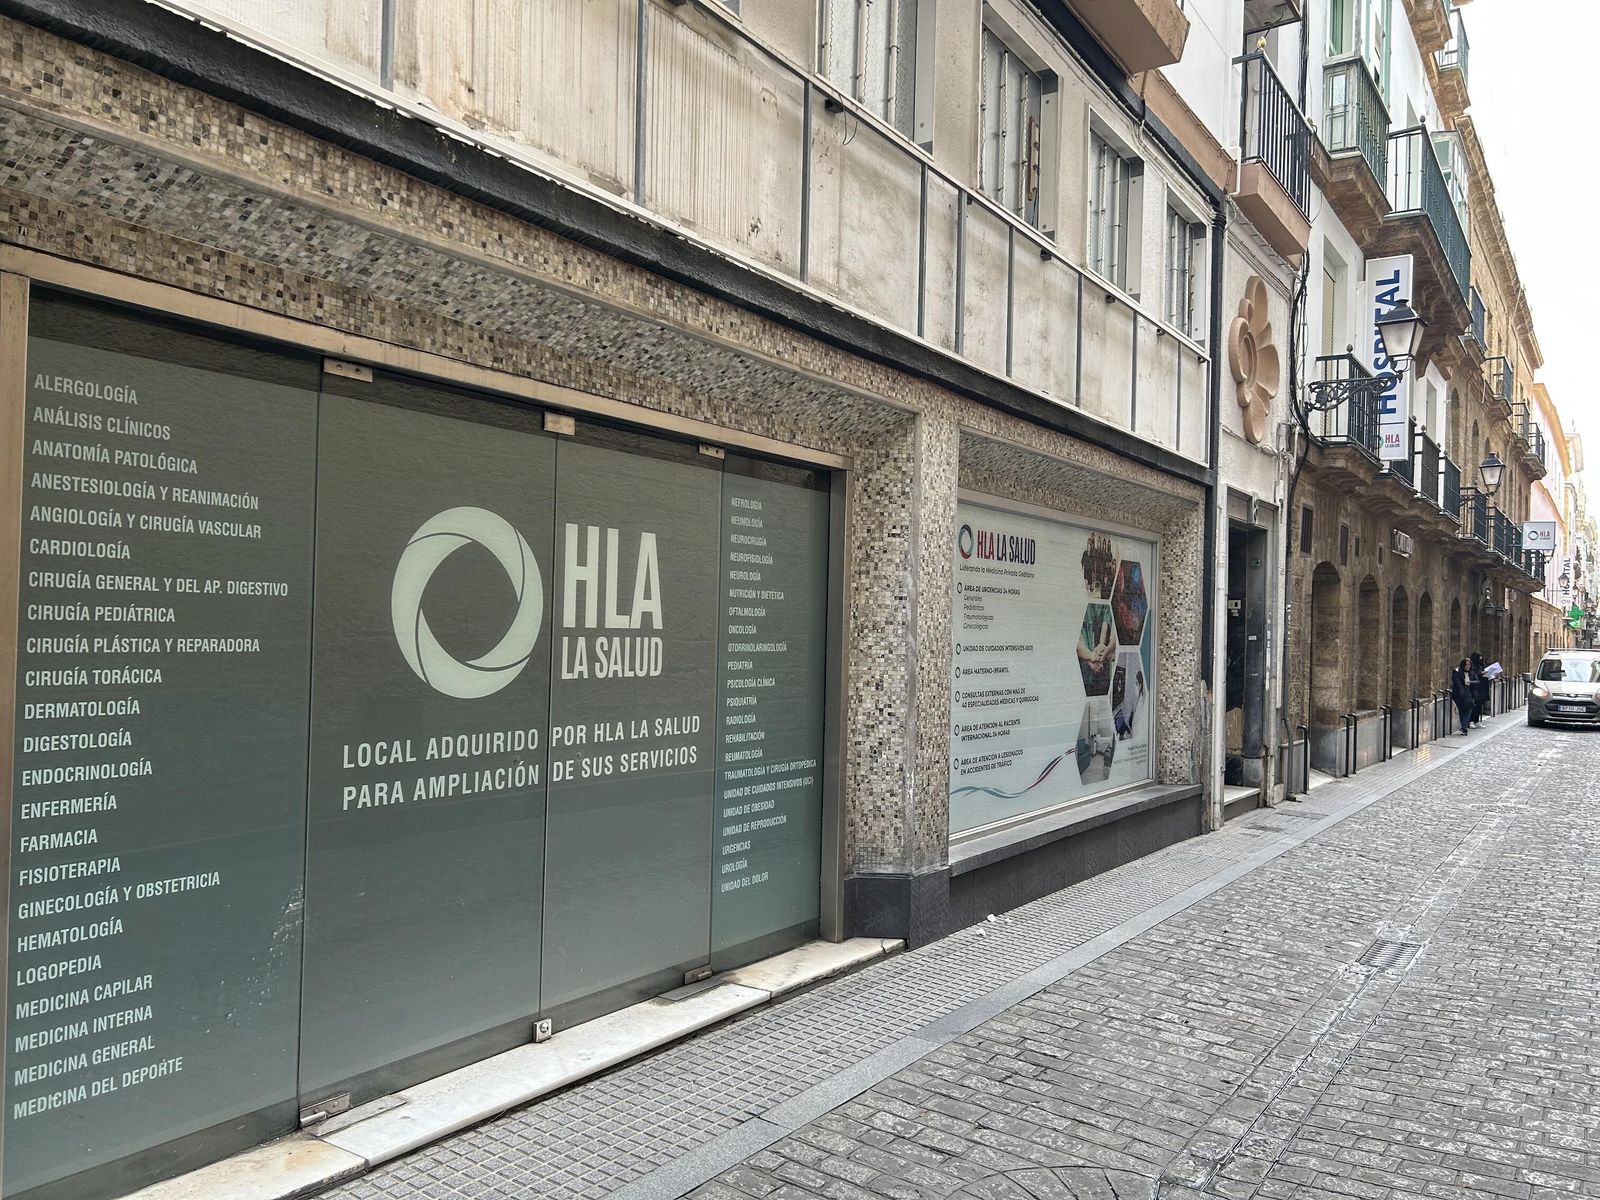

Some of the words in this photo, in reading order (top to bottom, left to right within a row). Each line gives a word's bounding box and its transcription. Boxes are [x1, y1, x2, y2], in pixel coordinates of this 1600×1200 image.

[1373, 269, 1400, 415] HOSTAL
[34, 374, 138, 405] ALERGOLOGÍA
[33, 407, 102, 431] ANÁLISIS
[107, 417, 171, 440] CLÍNICOS
[1385, 434, 1400, 444] HLA
[32, 440, 110, 464] ANATOMÍA
[115, 449, 198, 474] PATOLÓGICA
[31, 473, 155, 500] ANESTESIOLOGÍA
[160, 485, 168, 501] Y
[173, 486, 259, 510] REANIMACIÓN
[731, 498, 762, 510] NEFROLOGÍA
[30, 506, 122, 528] ANGIOLOGÍA
[127, 514, 134, 528] Y
[140, 515, 194, 533] CIRUGÍA
[199, 519, 261, 538] VASCULAR
[731, 516, 763, 528] NEUMOLOGÍA
[29, 539, 131, 559] CARDIOLOGÍA
[730, 534, 767, 546] NEUROCIRUGÍA
[977, 530, 994, 560] HLA
[997, 533, 1007, 562] LA
[1009, 535, 1036, 565] SALUD
[730, 552, 773, 565] NEUROFISIOLOGÍA
[28, 572, 91, 589] CIRUGÍA
[96, 574, 159, 591] GENERAL
[164, 578, 172, 592] Y
[177, 578, 200, 593] DEL
[204, 579, 222, 594] AP.
[227, 580, 288, 596] DIGESTIVO
[561, 522, 664, 629] HLA
[730, 571, 761, 581] NEUROLOGÍA
[1562, 558, 1570, 595] HOITAL
[729, 589, 756, 599] NUTRICIÓN
[757, 590, 760, 599] Y
[762, 590, 784, 600] DIETÉTICA
[28, 605, 90, 621] CIRUGÍA
[95, 606, 175, 622] PEDIÁTRICA
[729, 607, 766, 617] OFTALMOLOGÍA
[728, 625, 757, 634] ONCOLOGÍA
[26, 638, 88, 653] CIRUGÍA
[94, 638, 160, 653] PLÁSTICA
[165, 638, 172, 652] Y
[177, 638, 260, 652] REPARADORA
[561, 636, 588, 680] LA
[595, 636, 664, 679] SALUD
[728, 660, 753, 670] PEDIATRÍA
[25, 670, 88, 686] CIRUGÍA
[93, 669, 162, 684] TORÁCICA
[727, 678, 756, 689] PSICOLOGÍA
[757, 678, 776, 687] CLÍNICA
[24, 698, 140, 719] DERMATOLOGÍA
[727, 695, 757, 707] PSIQUIATRÍA
[726, 713, 756, 725] RADIOLOGÍA
[23, 729, 132, 752] DIGESTOLOGÍA
[343, 739, 416, 769] LOCAL
[426, 729, 538, 760] ADQUIRIDO
[553, 725, 586, 748] POR
[594, 721, 624, 744] HLA
[631, 719, 648, 740] LA
[655, 715, 701, 738] SALUD
[725, 731, 765, 744] REHABILITACIÓN
[725, 748, 763, 762] REUMATOLOGÍA
[22, 759, 152, 786] ENDOCRINOLOGÍA
[343, 780, 404, 811] PARA
[413, 761, 539, 801] AMPLIACIÓN
[553, 760, 574, 782] DE
[582, 755, 613, 779] SUS
[620, 745, 698, 774] SERVICIOS
[724, 766, 765, 781] TRAUMATOLOGÍA
[766, 765, 770, 775] Y
[771, 762, 789, 774] CIRUGÍA
[790, 758, 817, 771] ORTOPÉDICA
[724, 787, 743, 800] UNIDAD
[744, 786, 750, 796] DE
[752, 782, 776, 795] CUIDADOS
[777, 778, 802, 791] INTENSIVOS
[21, 793, 117, 819] ENFERMERÍA
[723, 805, 742, 818] UNIDAD
[744, 804, 750, 814] DE
[751, 800, 775, 813] OBESIDAD
[723, 824, 742, 837] UNIDAD
[743, 822, 750, 833] DE
[751, 815, 788, 831] REPRODUCCIÓN
[20, 828, 98, 852] FARMACIA
[722, 841, 751, 855] URGENCIAS
[19, 857, 120, 886] FISIOTERAPIA
[722, 858, 747, 874] UROLOGÍA
[721, 878, 740, 893] UNIDAD
[742, 876, 751, 887] DEL
[752, 872, 769, 885] DOLOR
[18, 886, 118, 919] GINECOLOGÍA
[123, 886, 132, 902] Y
[137, 872, 221, 900] OBSTETRICIA
[17, 916, 123, 953] HEMATOLOGÍA
[17, 954, 102, 986] LOGOPEDIA
[16, 988, 89, 1019] MEDICINA
[94, 974, 153, 1002] CAPILAR
[15, 1020, 88, 1052] MEDICINA
[93, 1005, 152, 1034] INTERNA
[14, 1052, 87, 1086] MEDICINA
[92, 1035, 155, 1066] GENERAL
[13, 1084, 87, 1120] MEDICINA
[92, 1075, 117, 1097] DEL
[122, 1057, 183, 1089] DEPORTE
